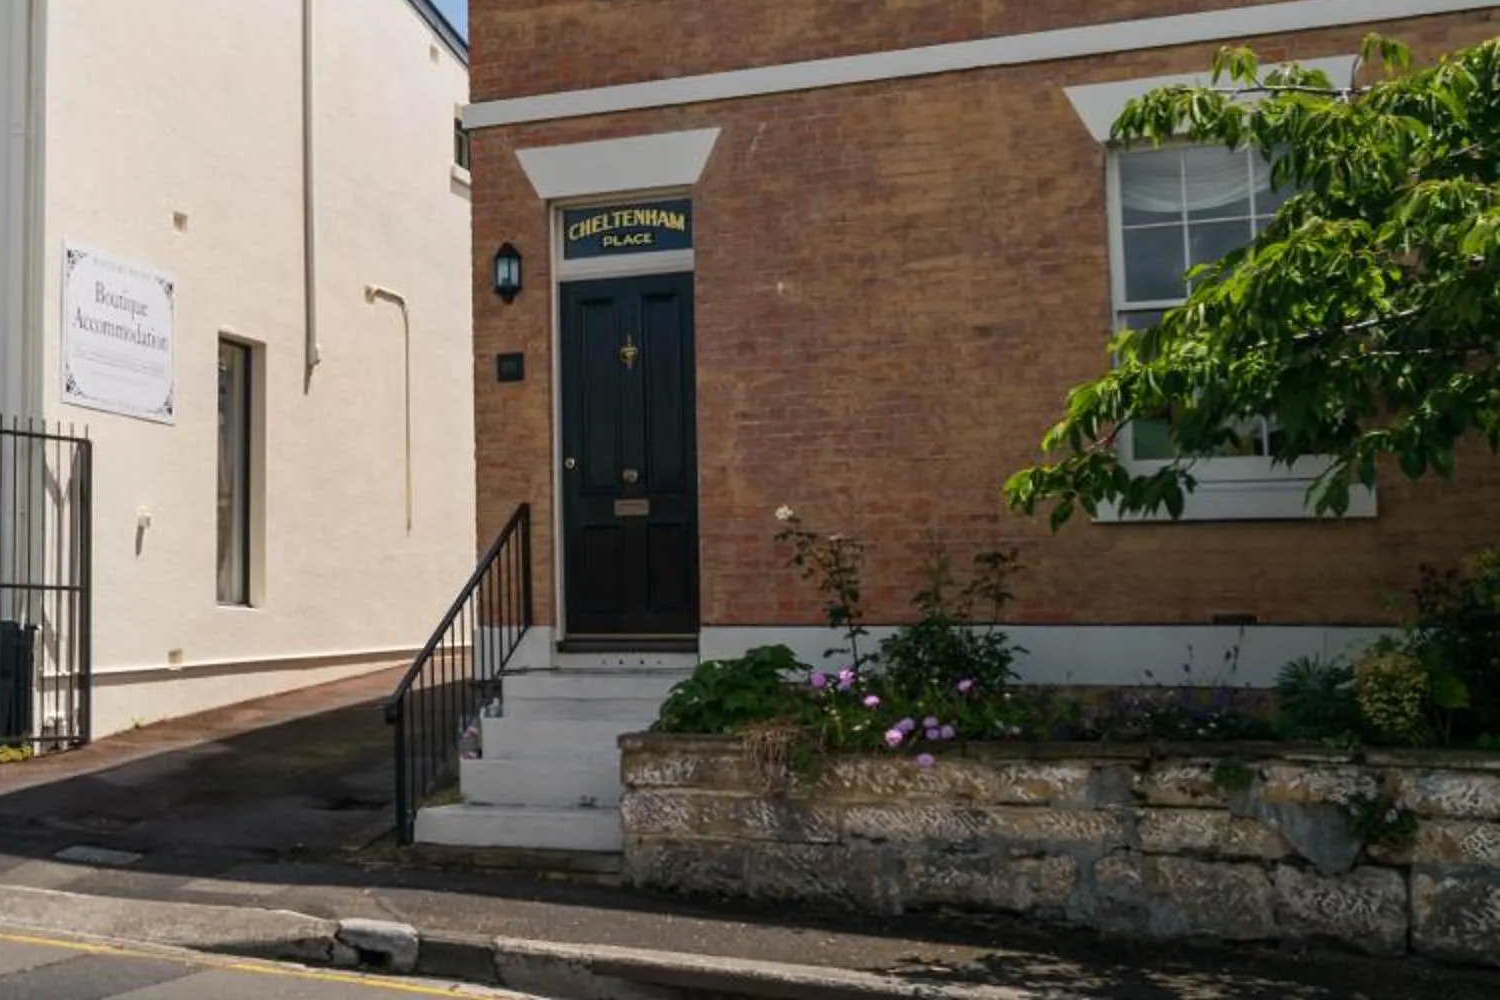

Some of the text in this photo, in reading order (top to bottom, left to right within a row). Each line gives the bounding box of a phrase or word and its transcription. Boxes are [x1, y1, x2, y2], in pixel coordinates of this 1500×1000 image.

[568, 208, 685, 241] CHELTENHAM
[603, 232, 652, 248] PLACE
[95, 280, 149, 320] Boutique
[72, 305, 168, 351] Accommodation
